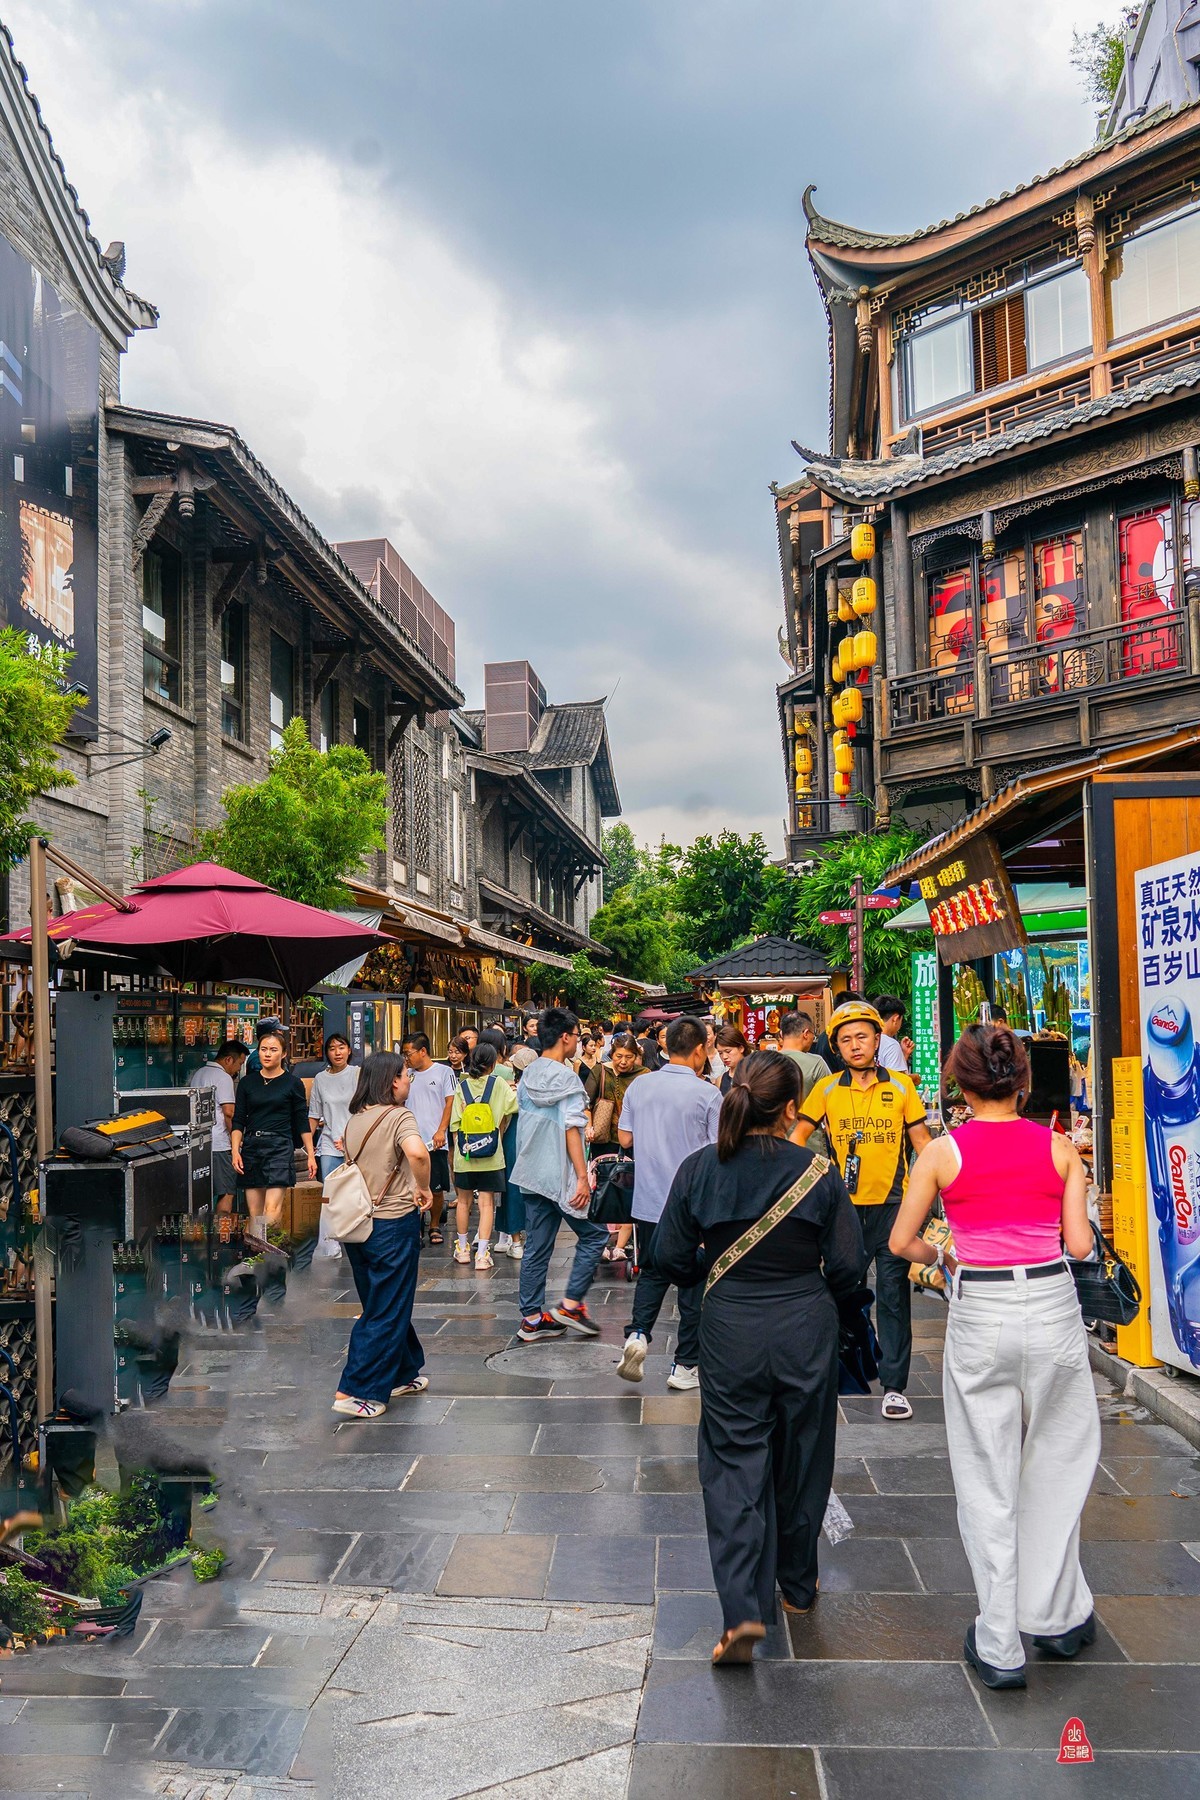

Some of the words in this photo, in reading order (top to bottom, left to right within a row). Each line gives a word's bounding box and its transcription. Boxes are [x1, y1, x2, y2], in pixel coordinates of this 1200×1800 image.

[1141, 867, 1200, 910] 真正天然
[1141, 899, 1200, 949] 矿泉水
[1142, 948, 1200, 987] 百岁山
[839, 1117, 893, 1131] 美团App
[1169, 1145, 1192, 1229] Ganten
